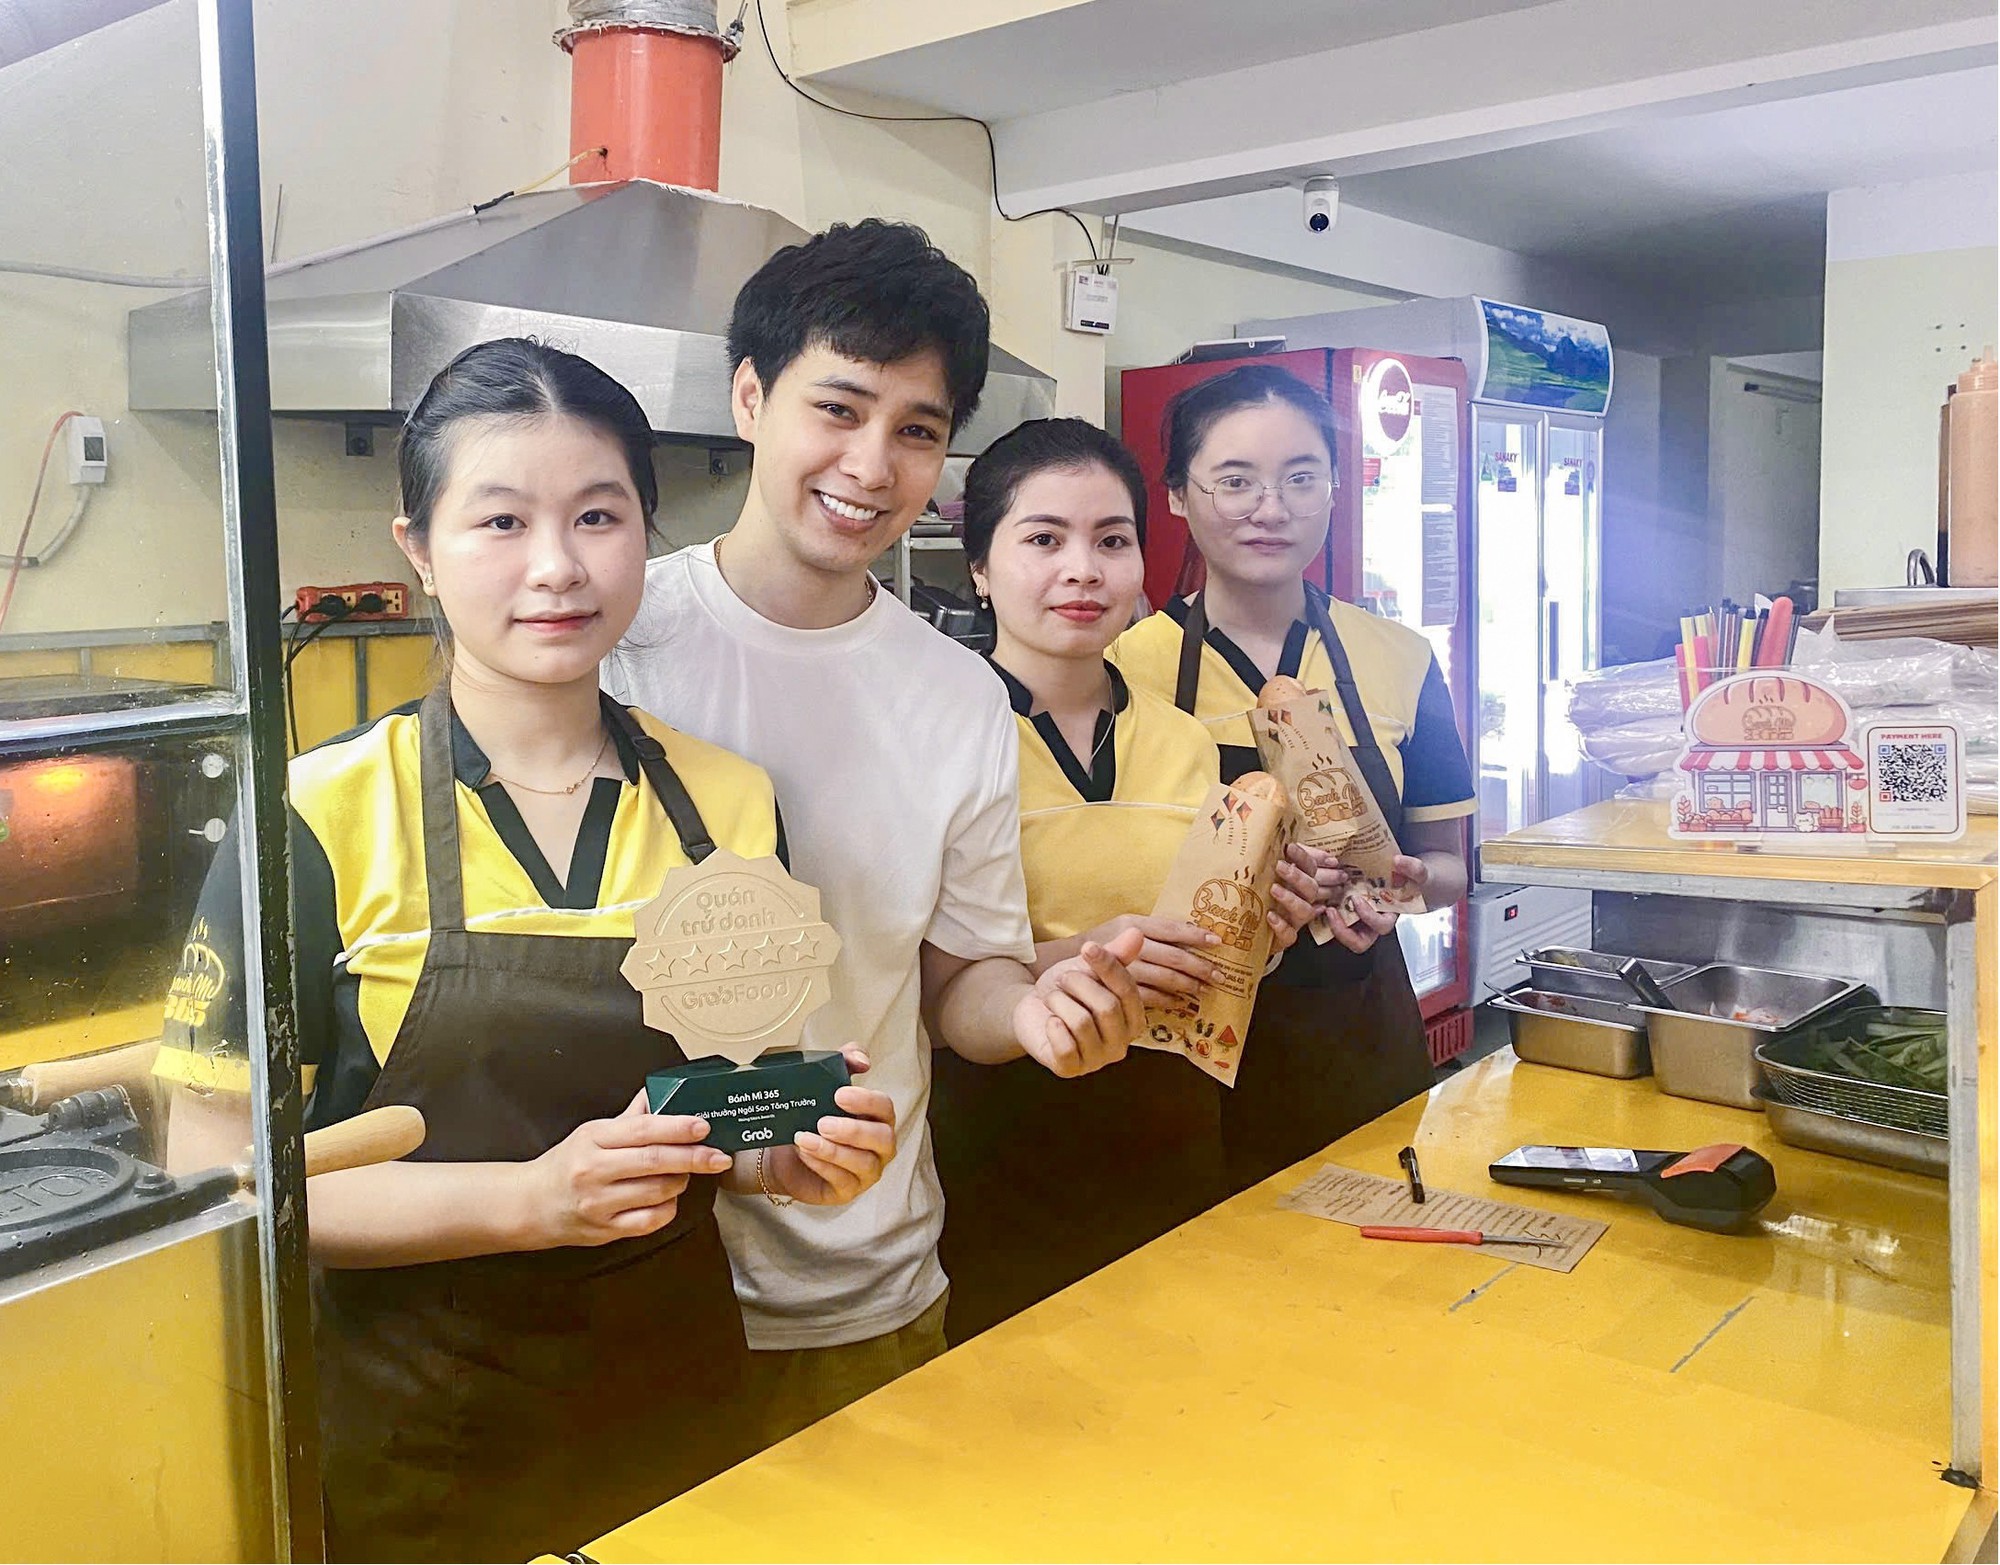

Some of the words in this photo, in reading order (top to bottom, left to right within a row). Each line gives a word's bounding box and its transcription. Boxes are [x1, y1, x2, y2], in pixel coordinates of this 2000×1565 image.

[719, 906, 776, 932] danh
[681, 976, 790, 1010] GrabFood
[727, 1093, 751, 1104] Bánh
[763, 1089, 780, 1100] 365
[755, 1104, 770, 1113] Sao
[741, 1127, 774, 1142] Grab
